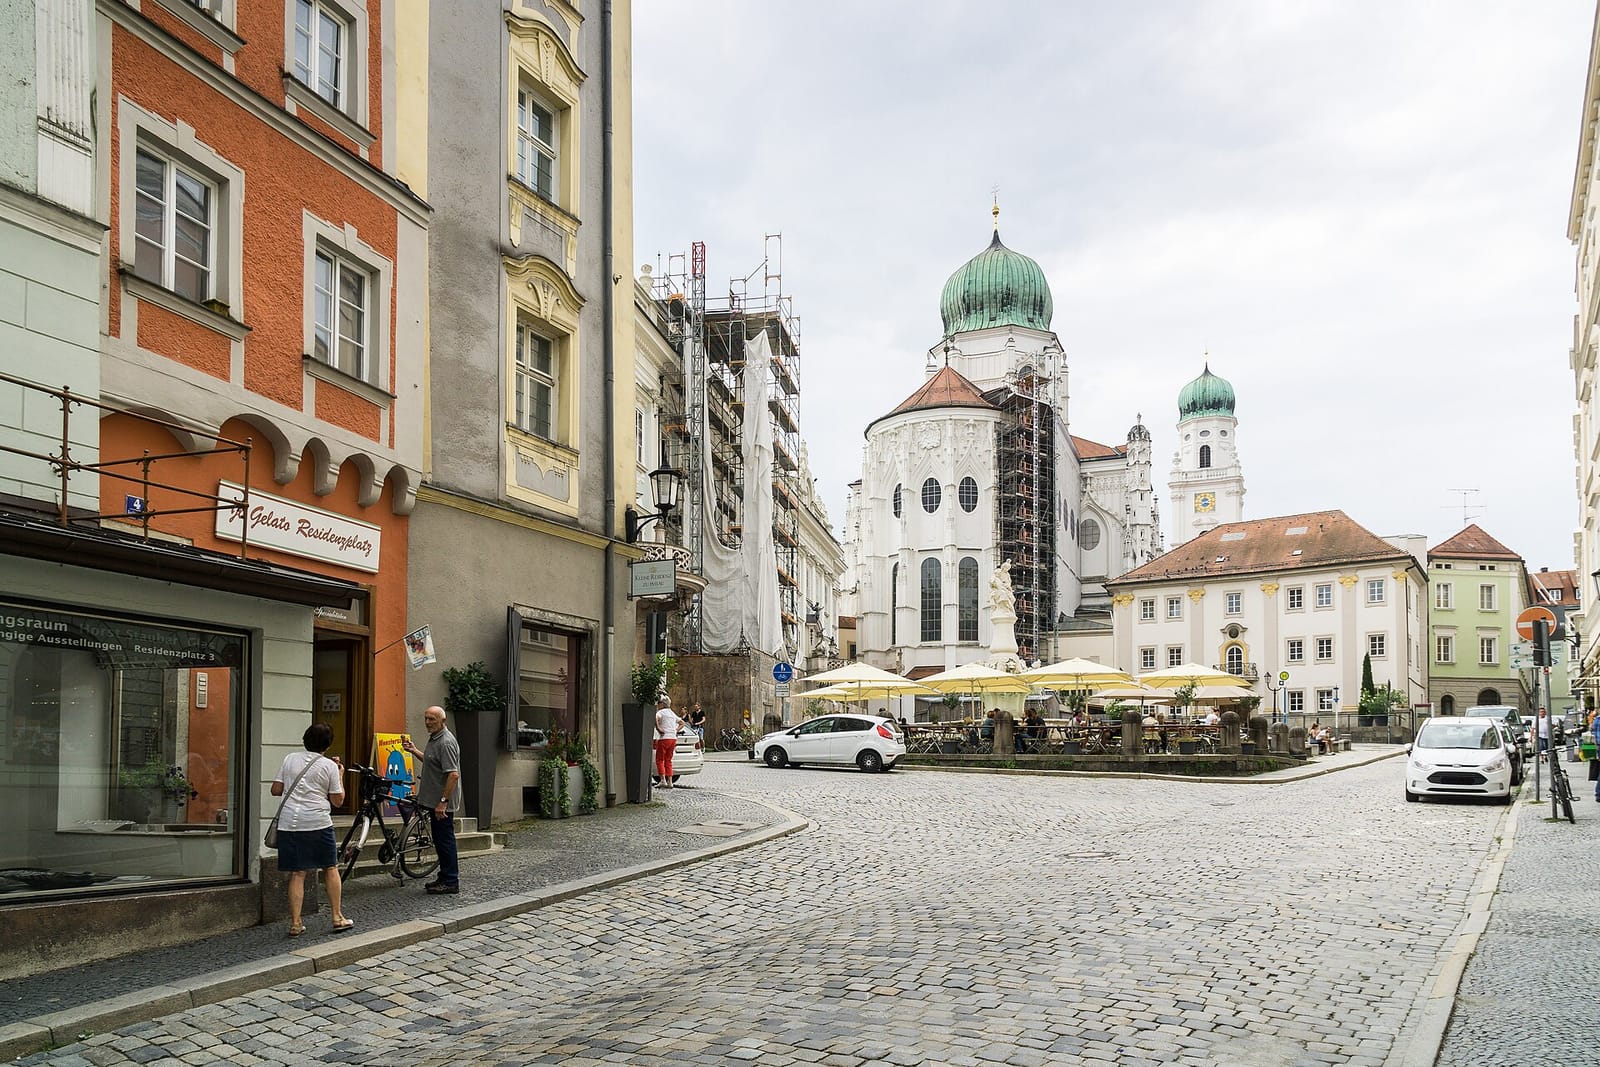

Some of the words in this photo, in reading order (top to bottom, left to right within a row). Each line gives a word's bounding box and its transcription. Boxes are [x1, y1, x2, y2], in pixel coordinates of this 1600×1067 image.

[133, 498, 141, 510] 4
[250, 505, 290, 531] Gelato
[296, 518, 373, 557] Residenzplatz
[37, 633, 122, 651] Ausstellungen
[134, 644, 206, 660] Residenzplatz
[209, 653, 215, 661] 3
